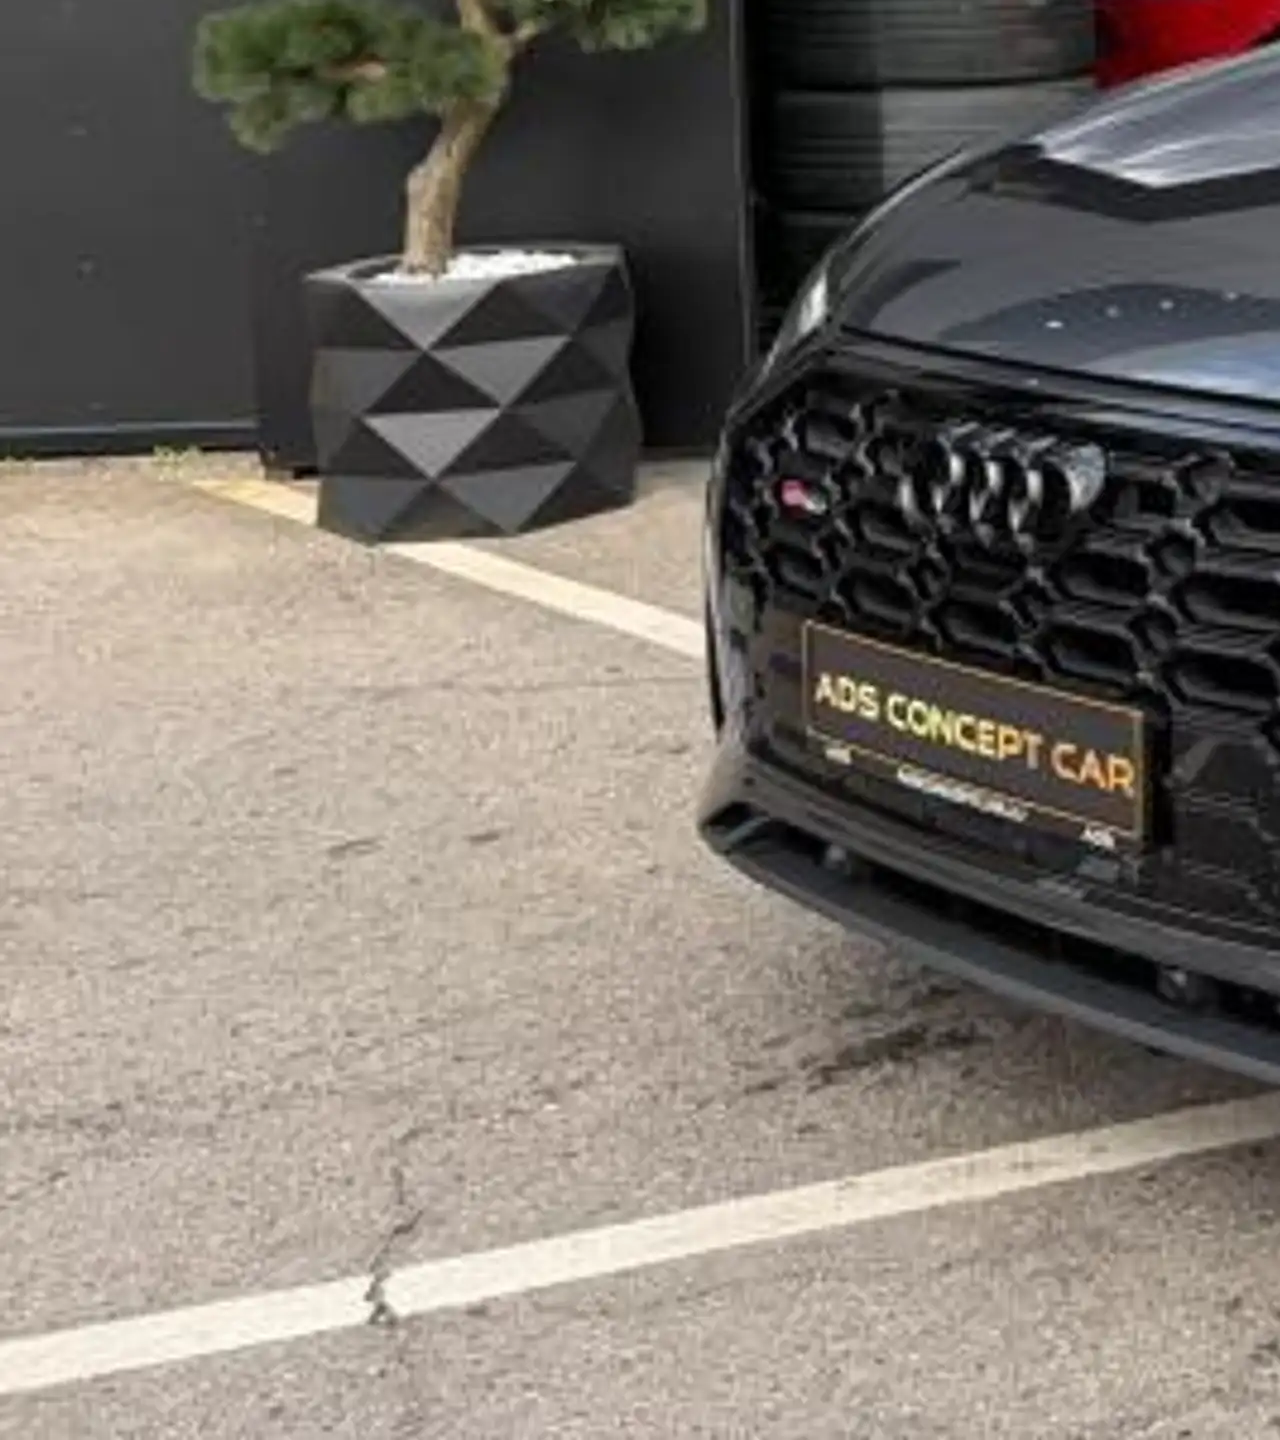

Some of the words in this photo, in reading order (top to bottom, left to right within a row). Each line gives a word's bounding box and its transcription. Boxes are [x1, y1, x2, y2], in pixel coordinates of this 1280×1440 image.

[814, 671, 879, 722] ADS
[886, 692, 1043, 770] CONCEPT
[1051, 742, 1136, 799] CAR
